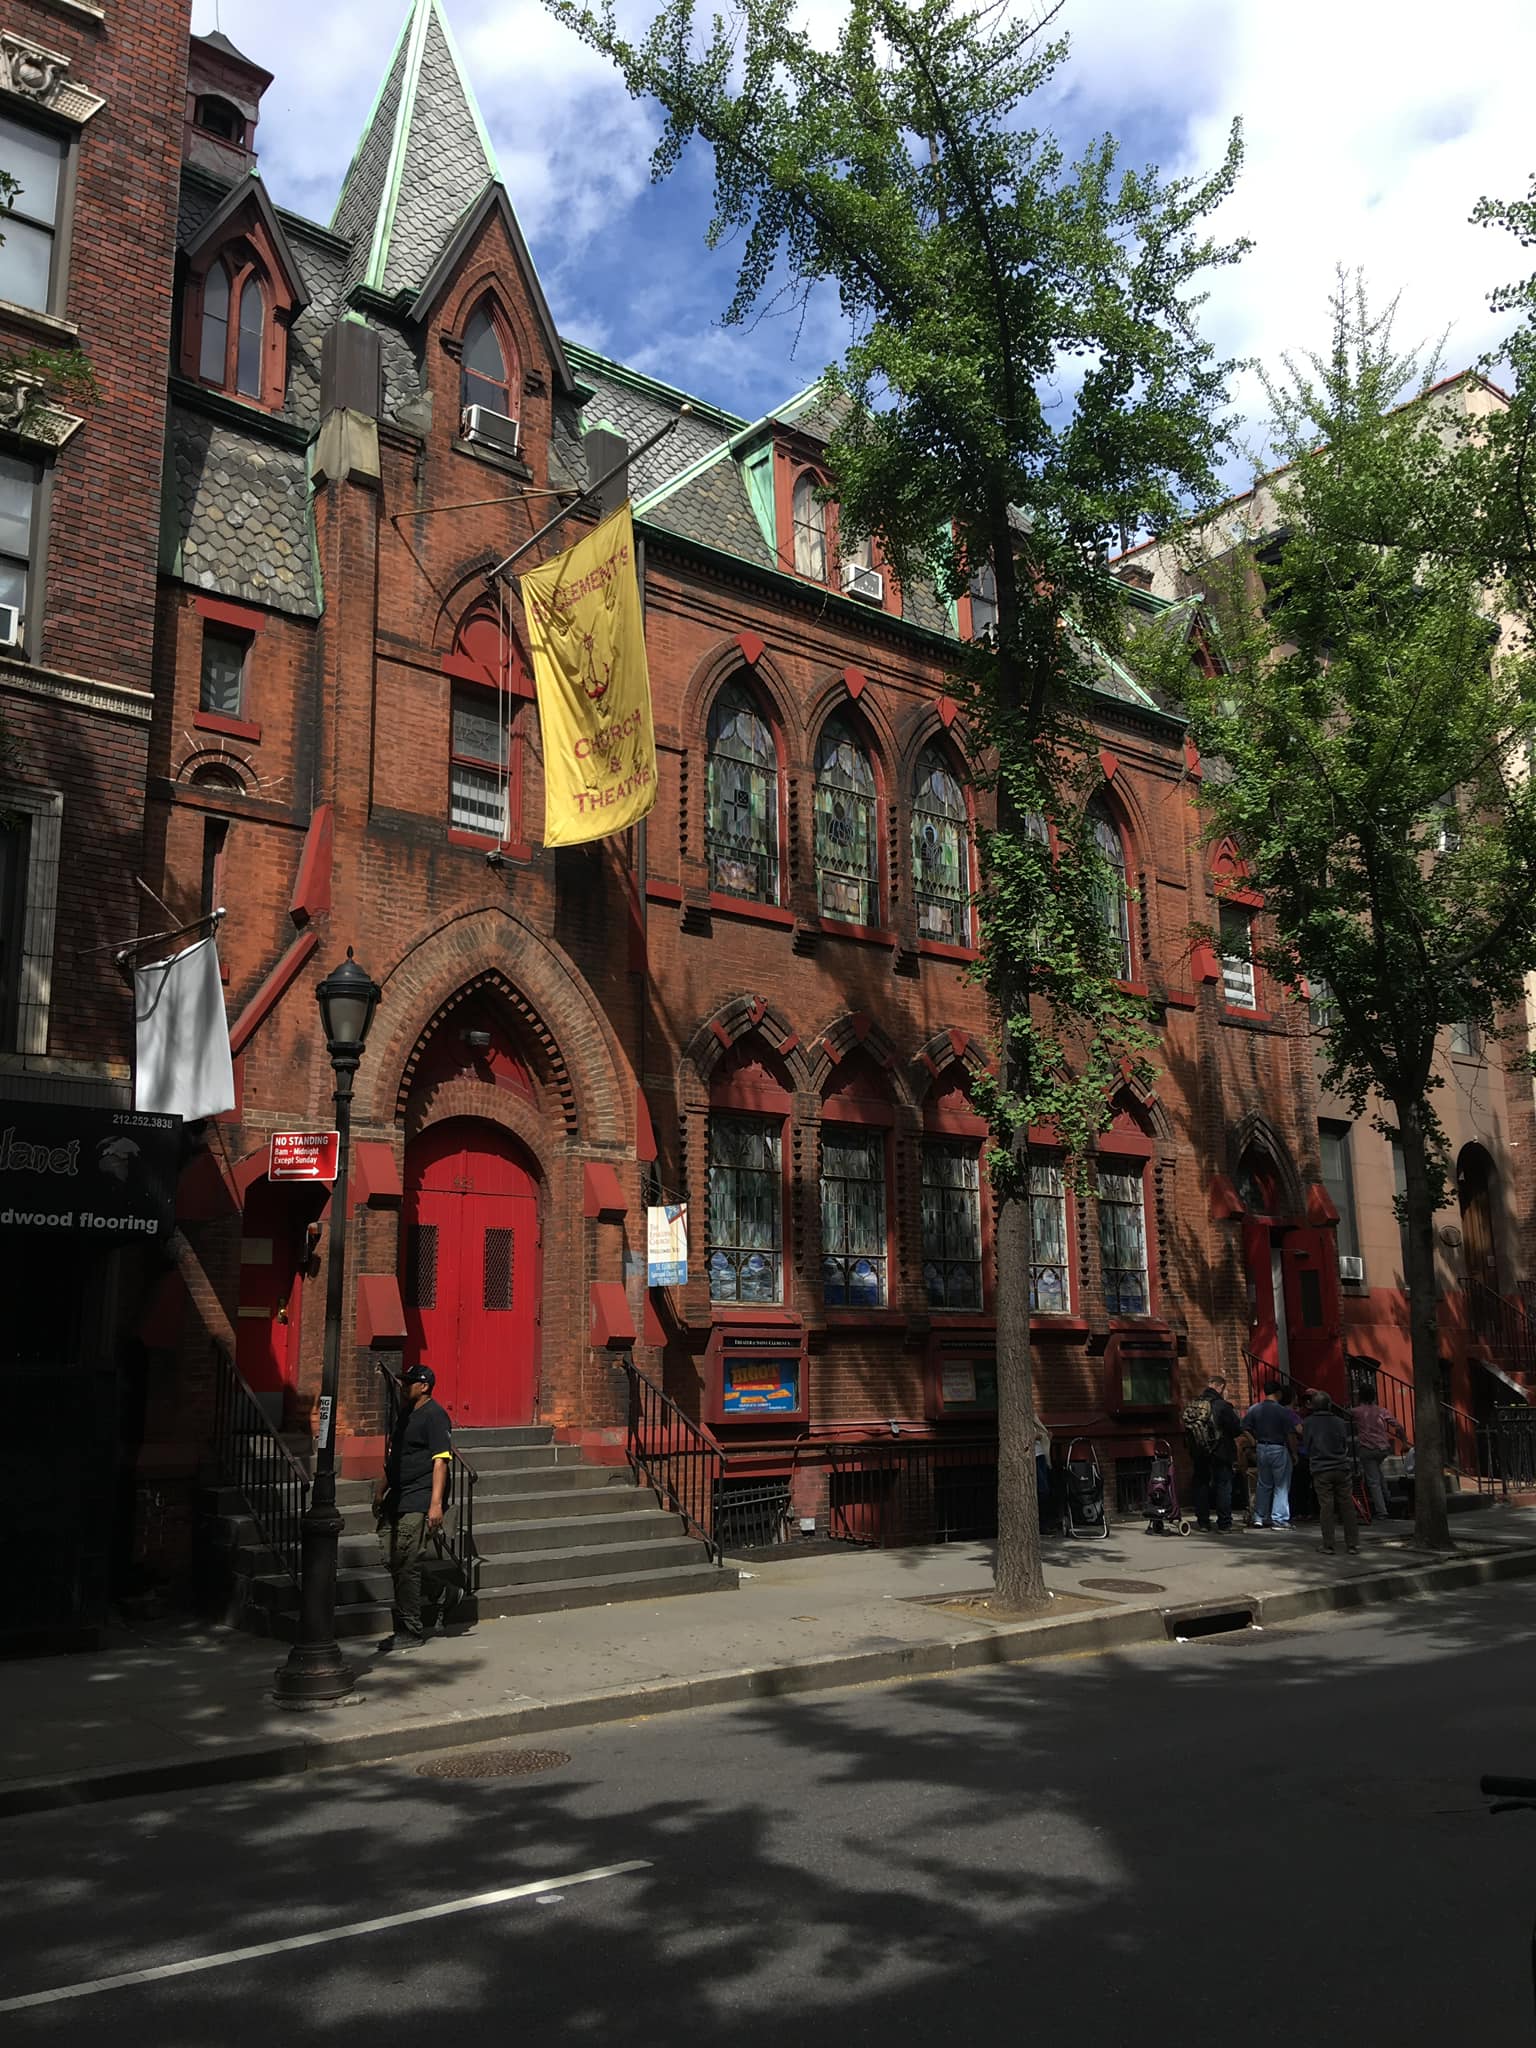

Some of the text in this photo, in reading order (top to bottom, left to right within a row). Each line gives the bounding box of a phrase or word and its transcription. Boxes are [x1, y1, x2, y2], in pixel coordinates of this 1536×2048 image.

[552, 545, 629, 613] CLEMENT'S
[574, 708, 642, 760] CHURCH
[610, 754, 622, 774] &
[573, 762, 650, 815] THEATRE
[0, 1126, 81, 1177] lanet
[275, 1136, 329, 1146] NO STANDING
[293, 1147, 319, 1156] Midnight
[274, 1155, 318, 1165] Except Sunday
[79, 1212, 159, 1235] flooring
